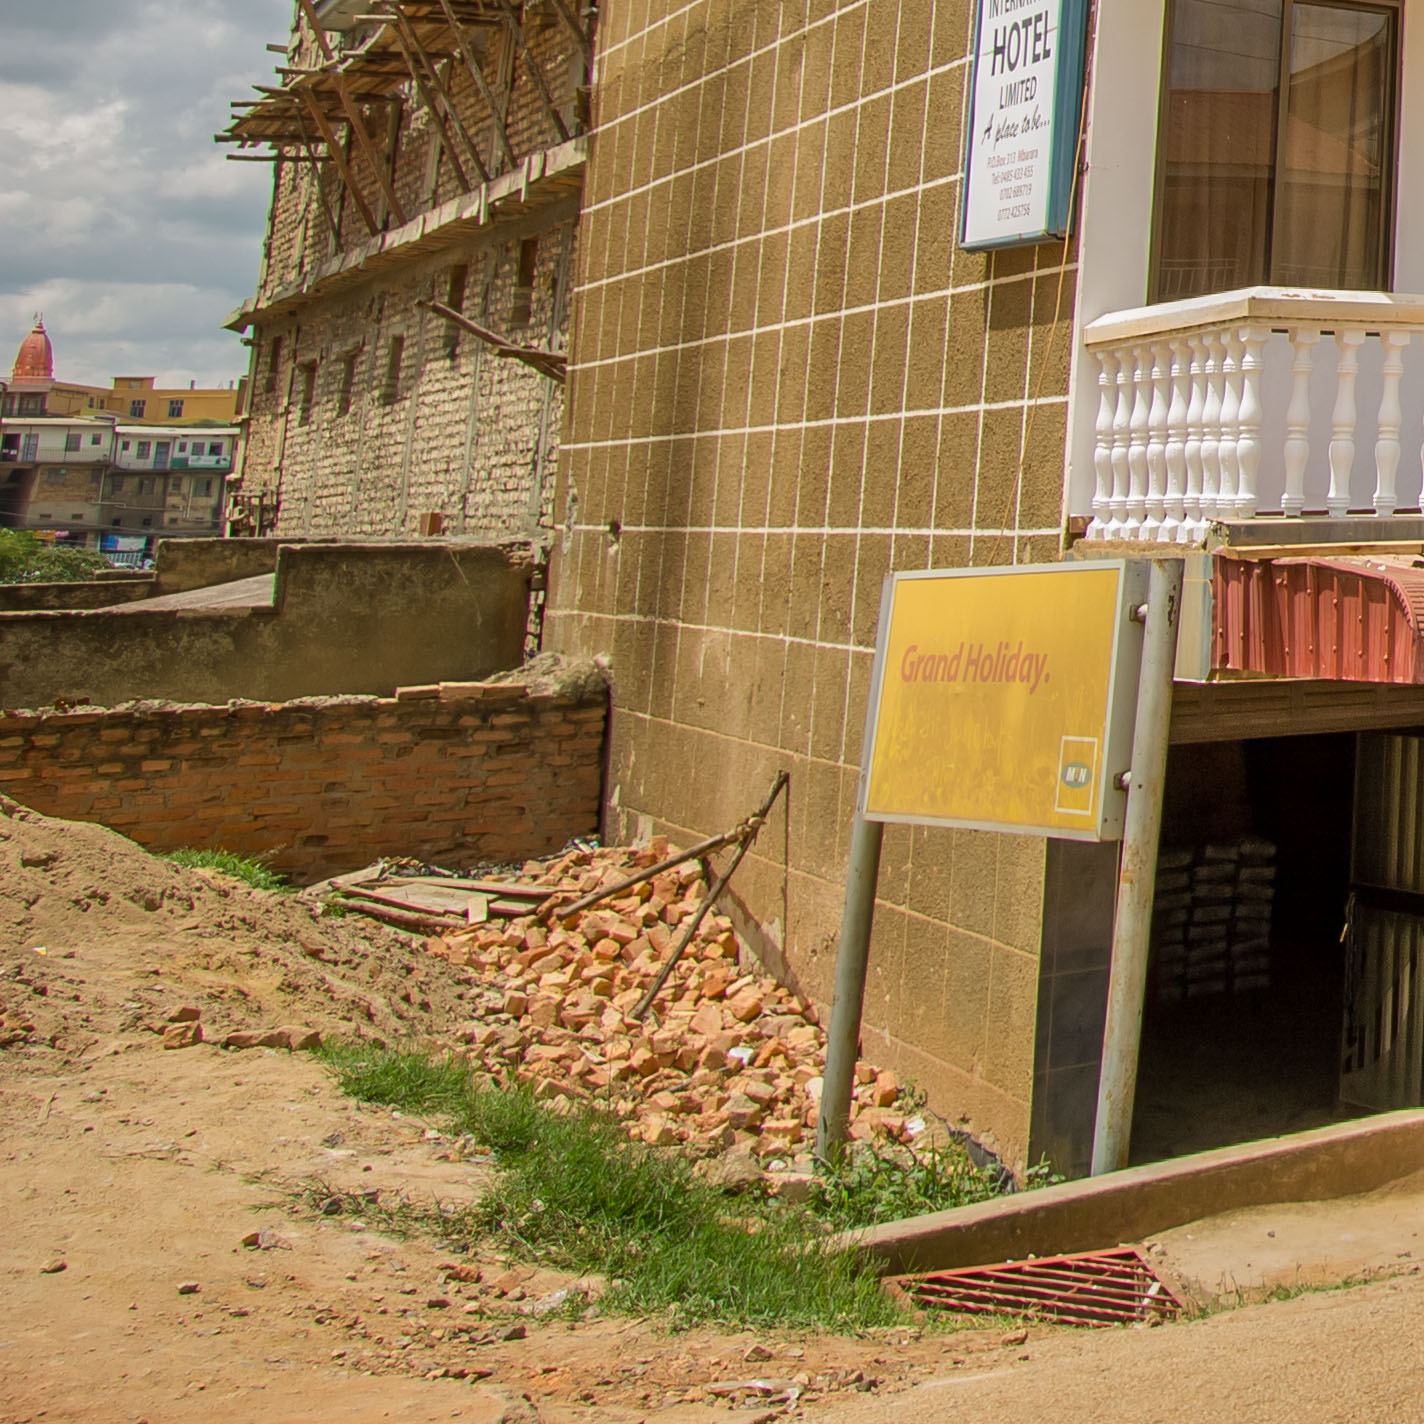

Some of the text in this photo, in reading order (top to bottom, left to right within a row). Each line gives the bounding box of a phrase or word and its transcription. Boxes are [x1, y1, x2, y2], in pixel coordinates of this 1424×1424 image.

[991, 10, 1051, 77] HOTEL
[999, 75, 1037, 110] LIMITED
[993, 117, 1019, 151] place
[901, 641, 965, 683] Grand
